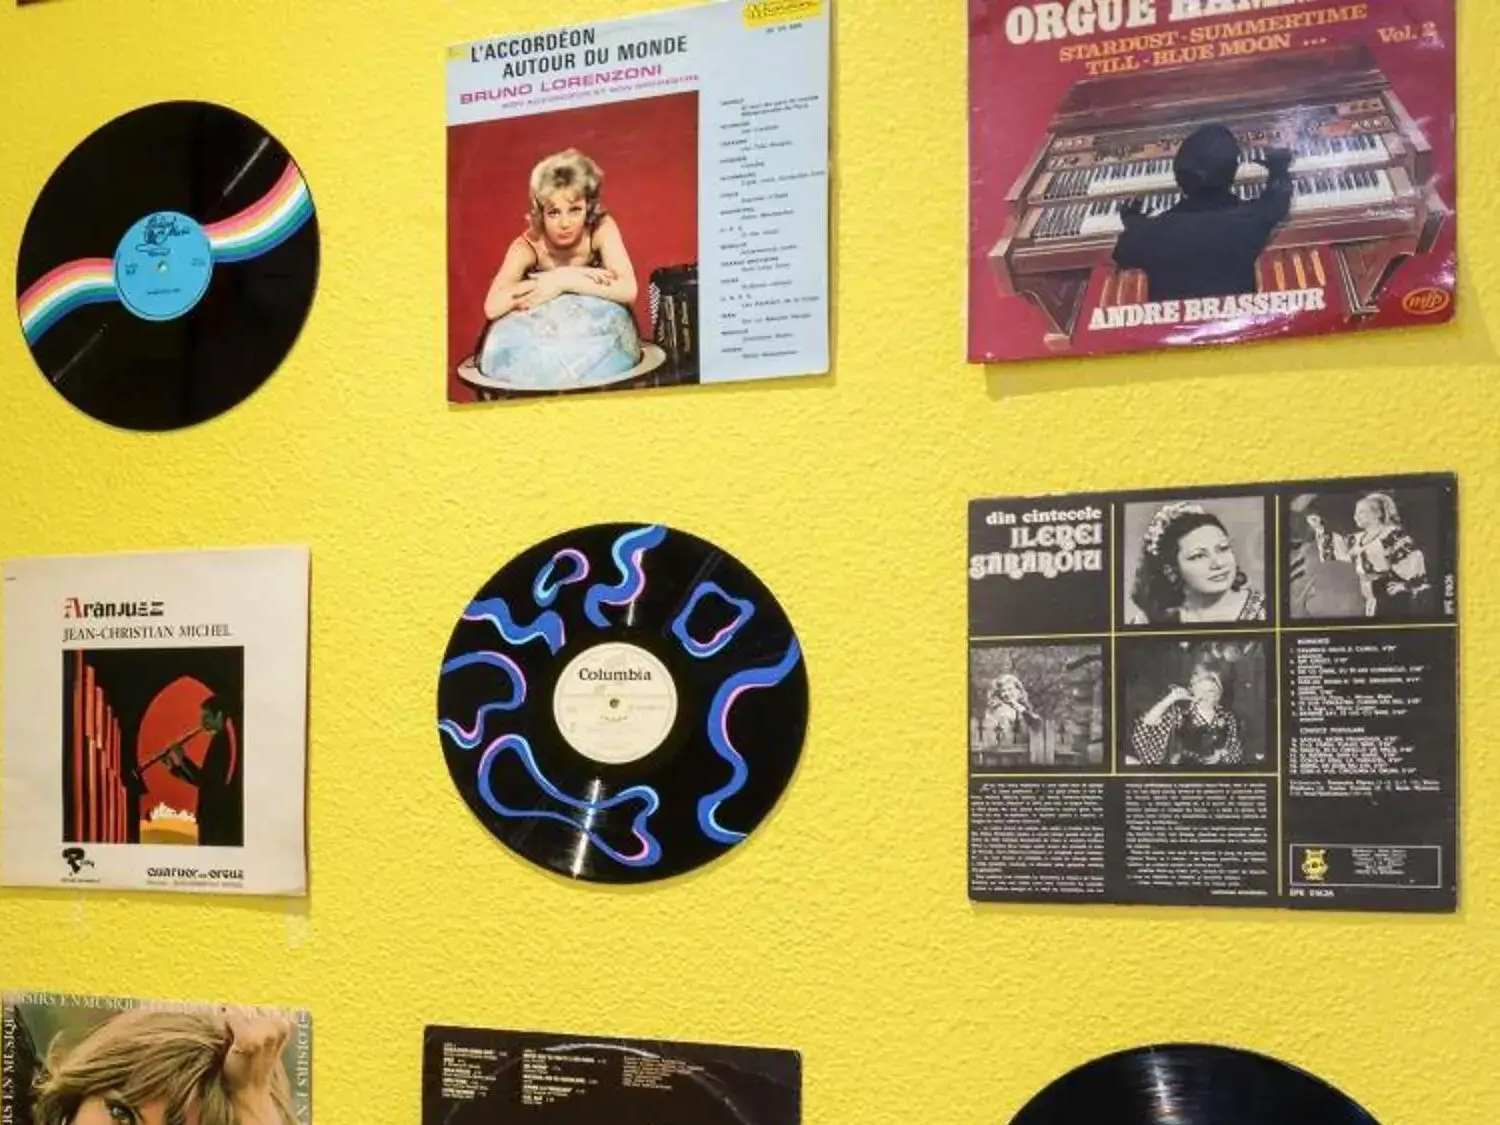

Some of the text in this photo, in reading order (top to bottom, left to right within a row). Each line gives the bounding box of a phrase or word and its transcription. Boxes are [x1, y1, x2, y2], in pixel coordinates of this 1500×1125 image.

[1005, 0, 1156, 45] ORGUE
[1059, 31, 1178, 62] STARDUST
[1190, 4, 1367, 43] SUMMERTIME
[1376, 25, 1417, 42] Vol.
[471, 28, 595, 63] L'ACCORDÉON
[502, 36, 688, 79] AUTOUR DU MONDE
[1085, 52, 1140, 75] TILL
[1153, 44, 1214, 66] BLUE
[1220, 33, 1290, 57] MOON
[460, 64, 662, 105] BRUNO LORENZONI
[1088, 288, 1326, 330] ANDRE BRASSEUR
[985, 510, 1016, 525] din
[62, 623, 232, 642] JEAN-CHRISTIAN MICHEL
[578, 667, 652, 681] Columbia
